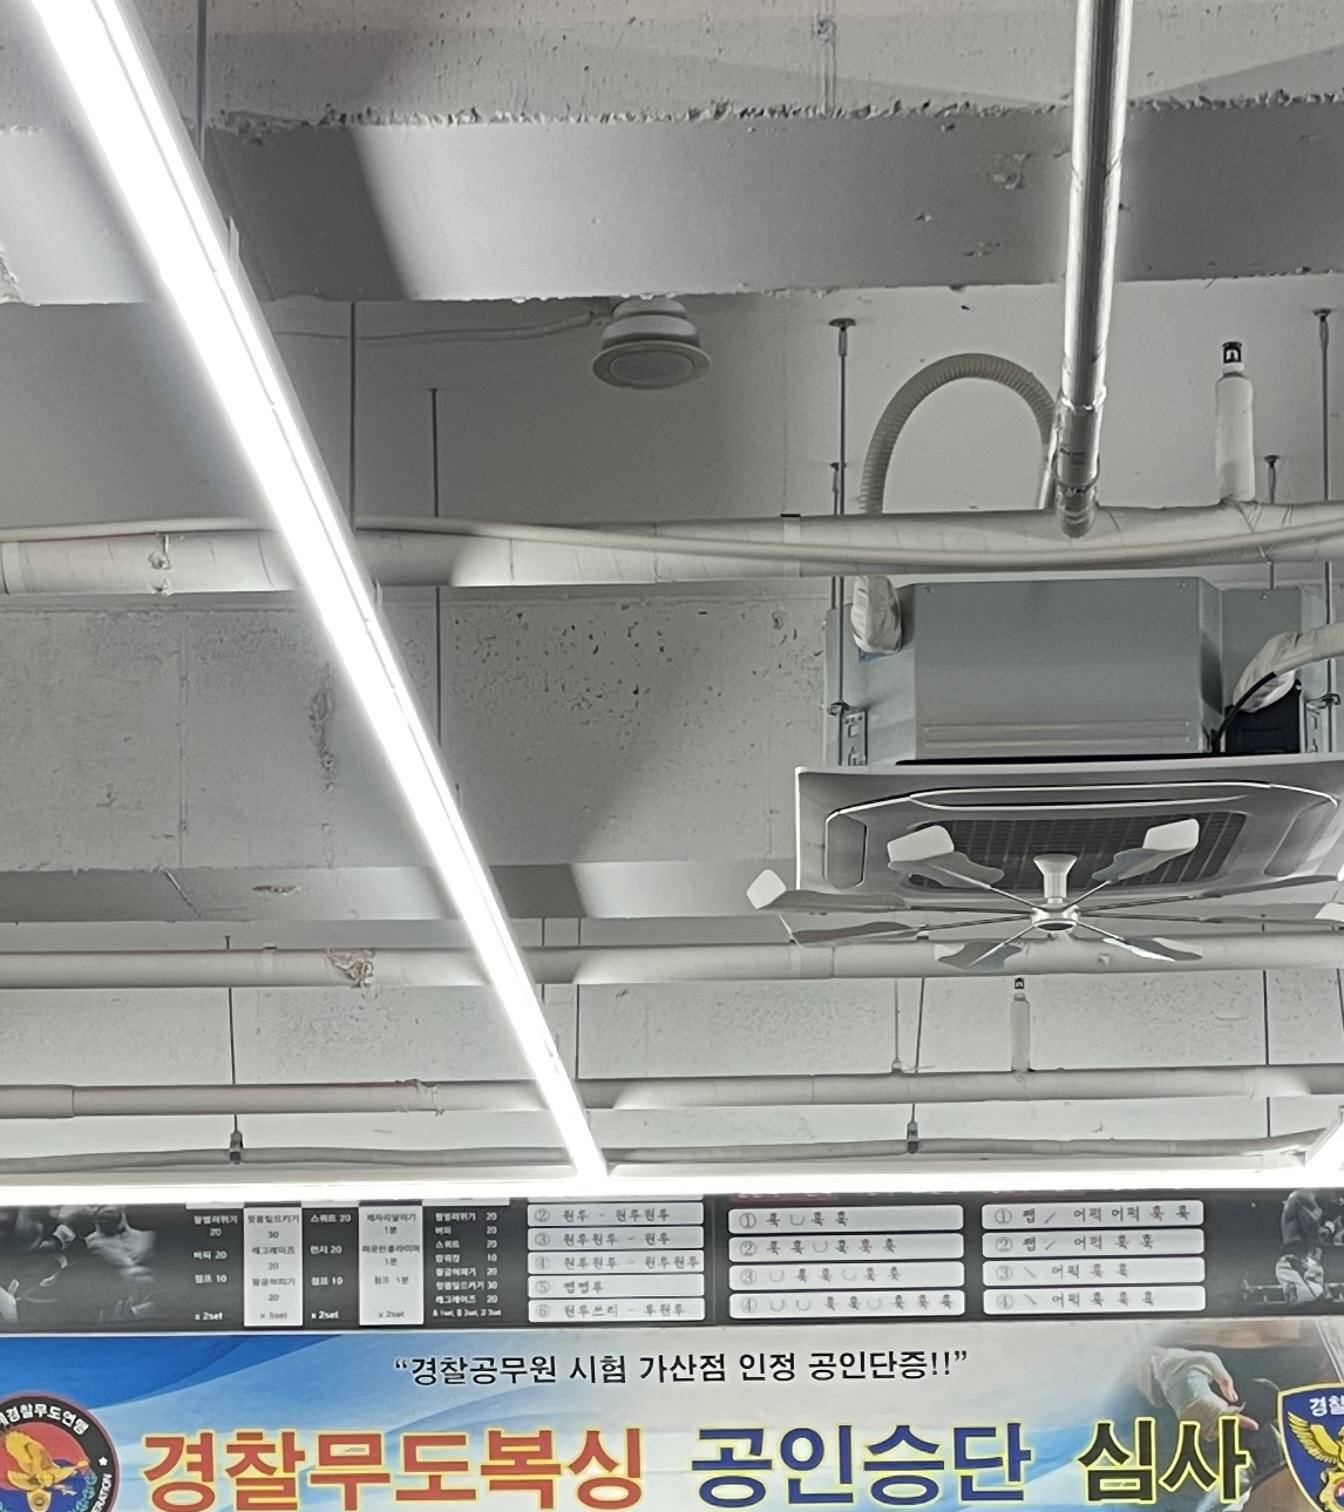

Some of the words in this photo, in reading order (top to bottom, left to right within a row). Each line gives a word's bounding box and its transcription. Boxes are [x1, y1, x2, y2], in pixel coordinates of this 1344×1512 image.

[394, 1355, 557, 1386] “경찰공무원
[570, 1354, 627, 1385] 시험
[639, 1352, 726, 1384] 가산점
[739, 1351, 796, 1382] 인정
[808, 1349, 968, 1381] 공인단증!!”
[688, 1420, 1034, 1509] 공인승단
[1076, 1415, 1249, 1504] 심사
